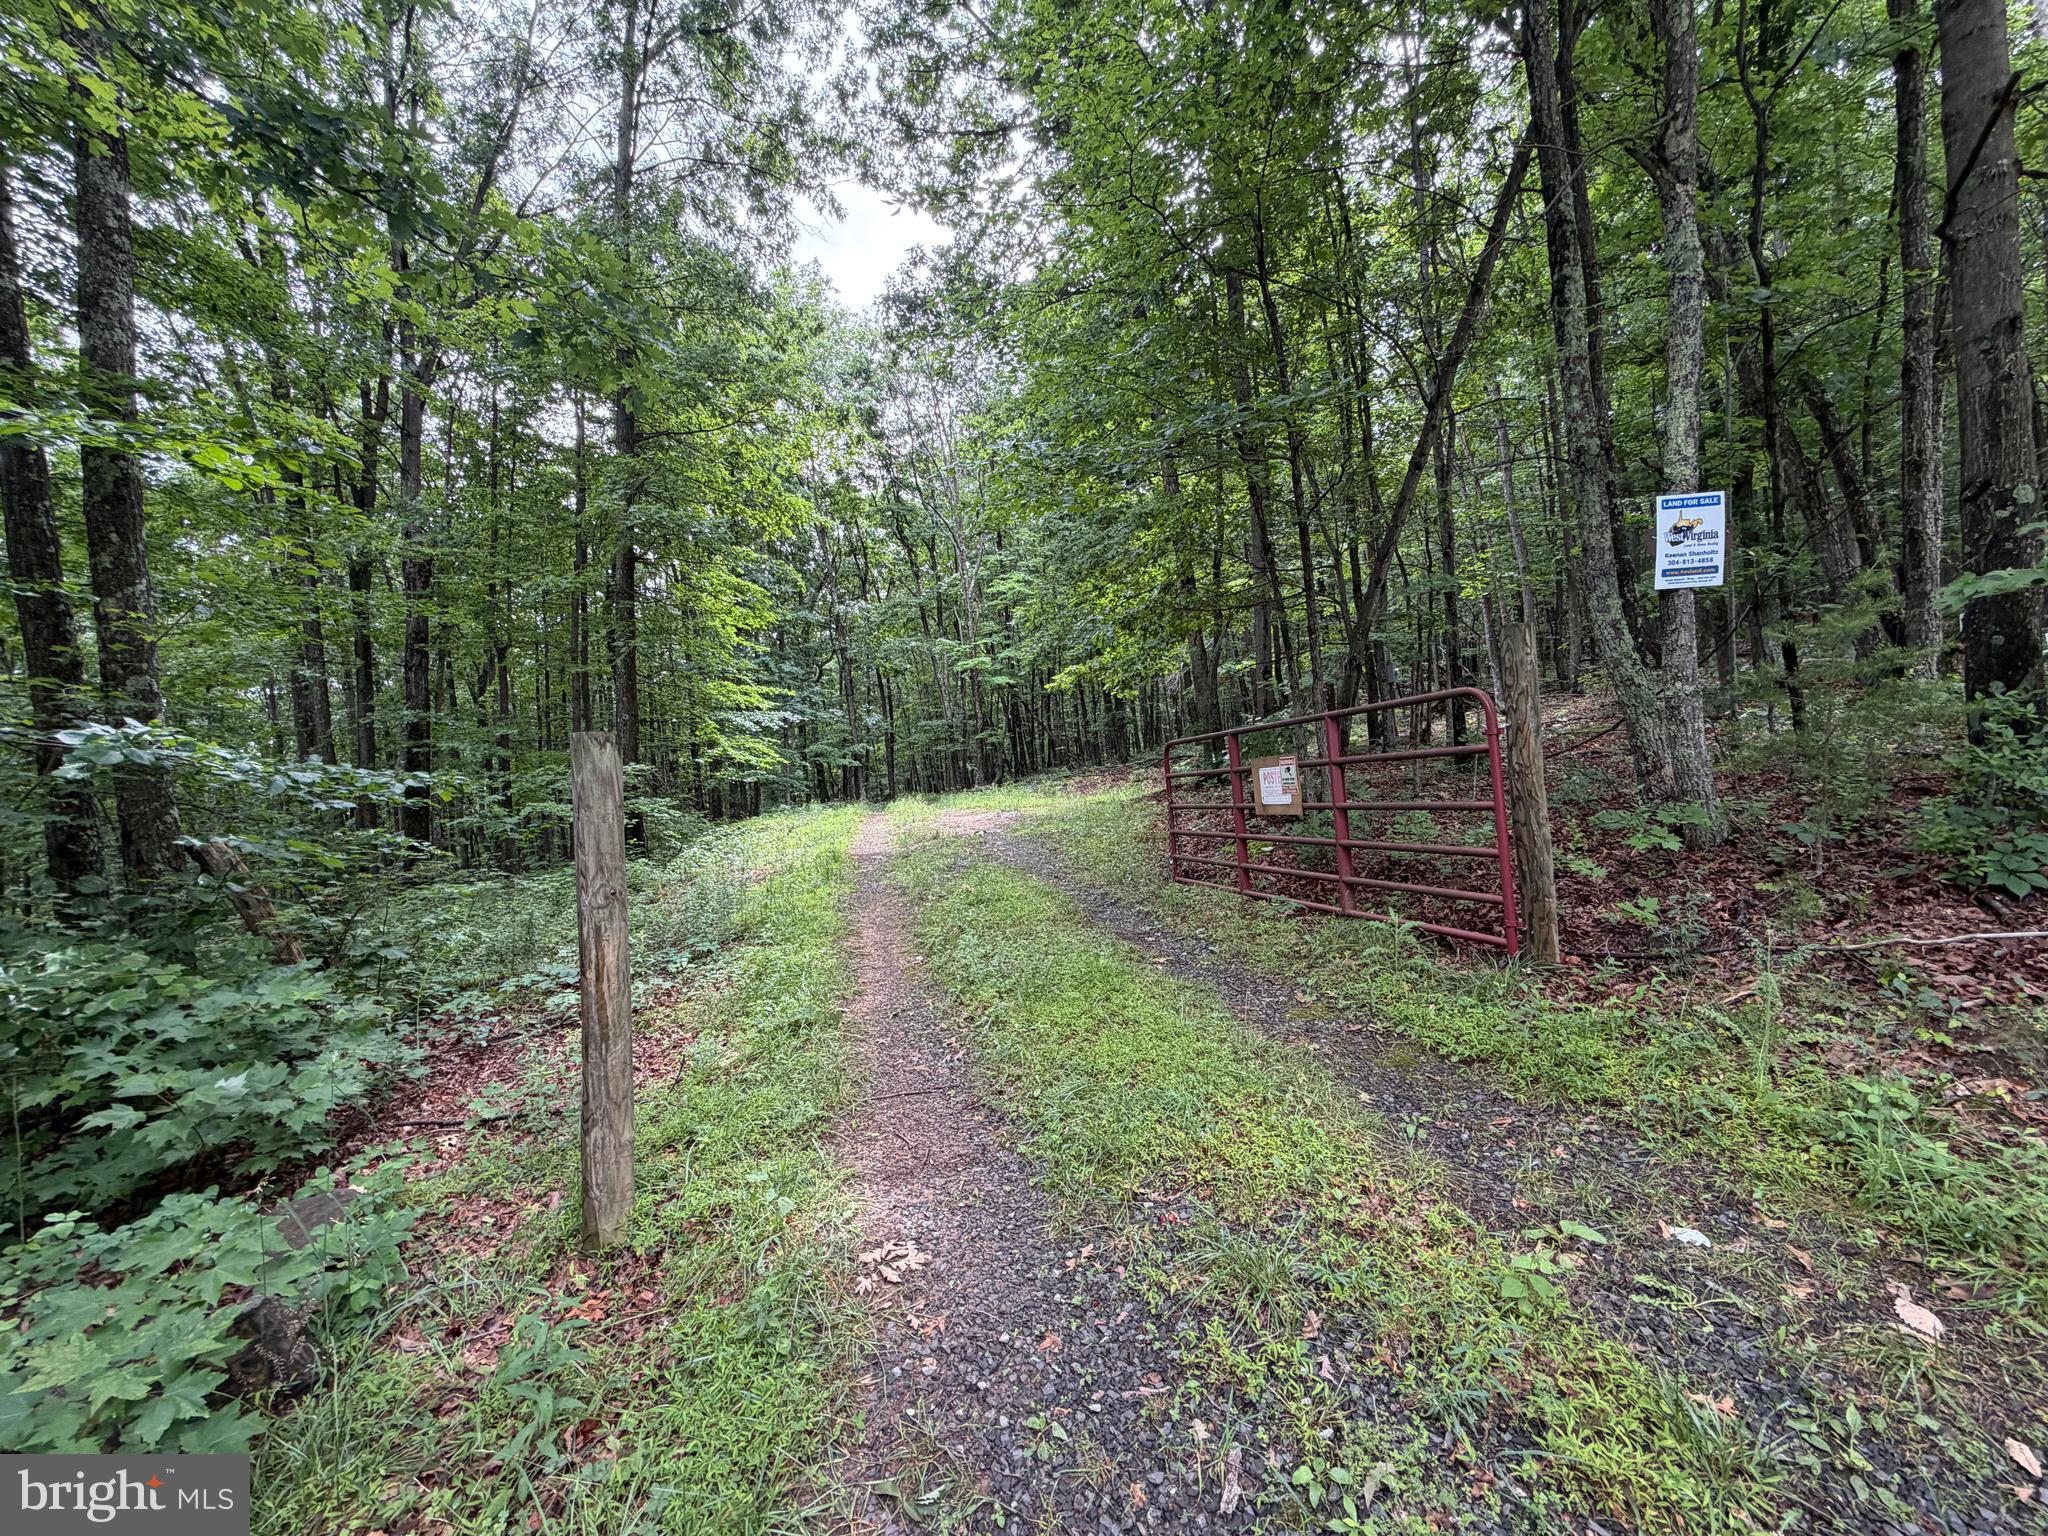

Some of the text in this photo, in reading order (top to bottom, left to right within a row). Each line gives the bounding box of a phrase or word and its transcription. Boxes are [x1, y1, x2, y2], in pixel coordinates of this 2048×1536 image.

[1663, 500, 1682, 508] LAND
[1700, 496, 1719, 504] SALE
[1663, 529, 1719, 543] West Virginia
[1688, 549, 1719, 557] Shanholtz
